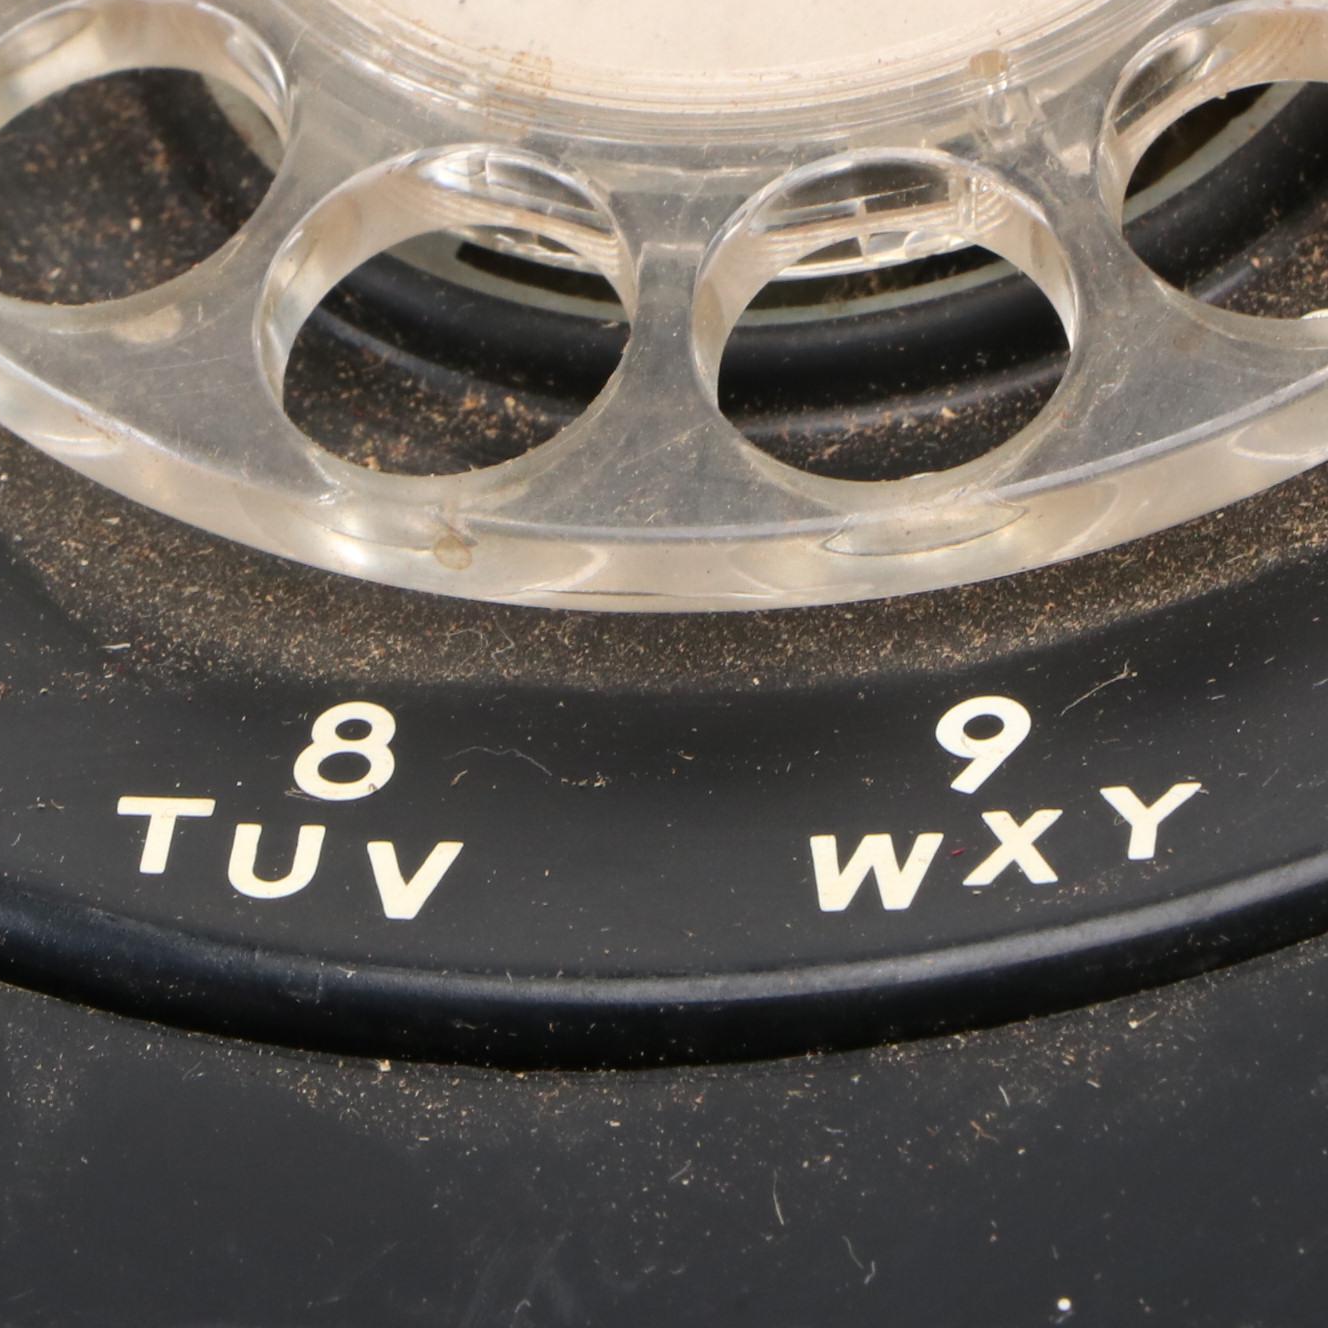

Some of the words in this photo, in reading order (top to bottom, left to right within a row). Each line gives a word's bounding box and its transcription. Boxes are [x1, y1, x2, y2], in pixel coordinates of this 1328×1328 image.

[292, 700, 397, 802] 8
[934, 694, 1033, 795] 9
[115, 795, 465, 922] TUV
[808, 780, 1204, 913] WXY
